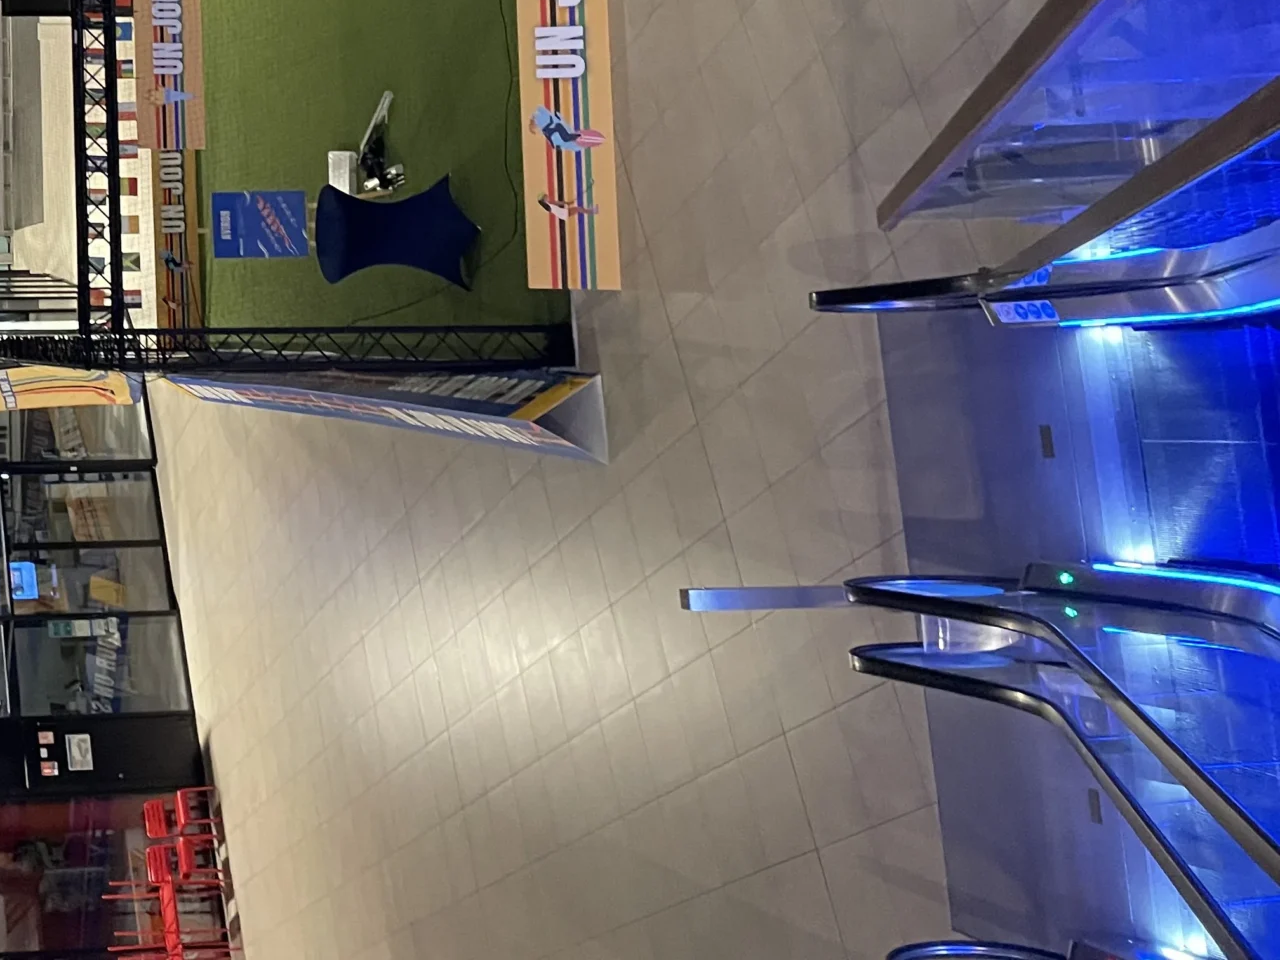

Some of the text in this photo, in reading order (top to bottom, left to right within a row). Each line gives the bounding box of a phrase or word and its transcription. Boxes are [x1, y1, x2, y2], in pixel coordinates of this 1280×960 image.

[152, 42, 183, 75] UN
[534, 26, 586, 79] UN
[160, 205, 185, 233] UN
